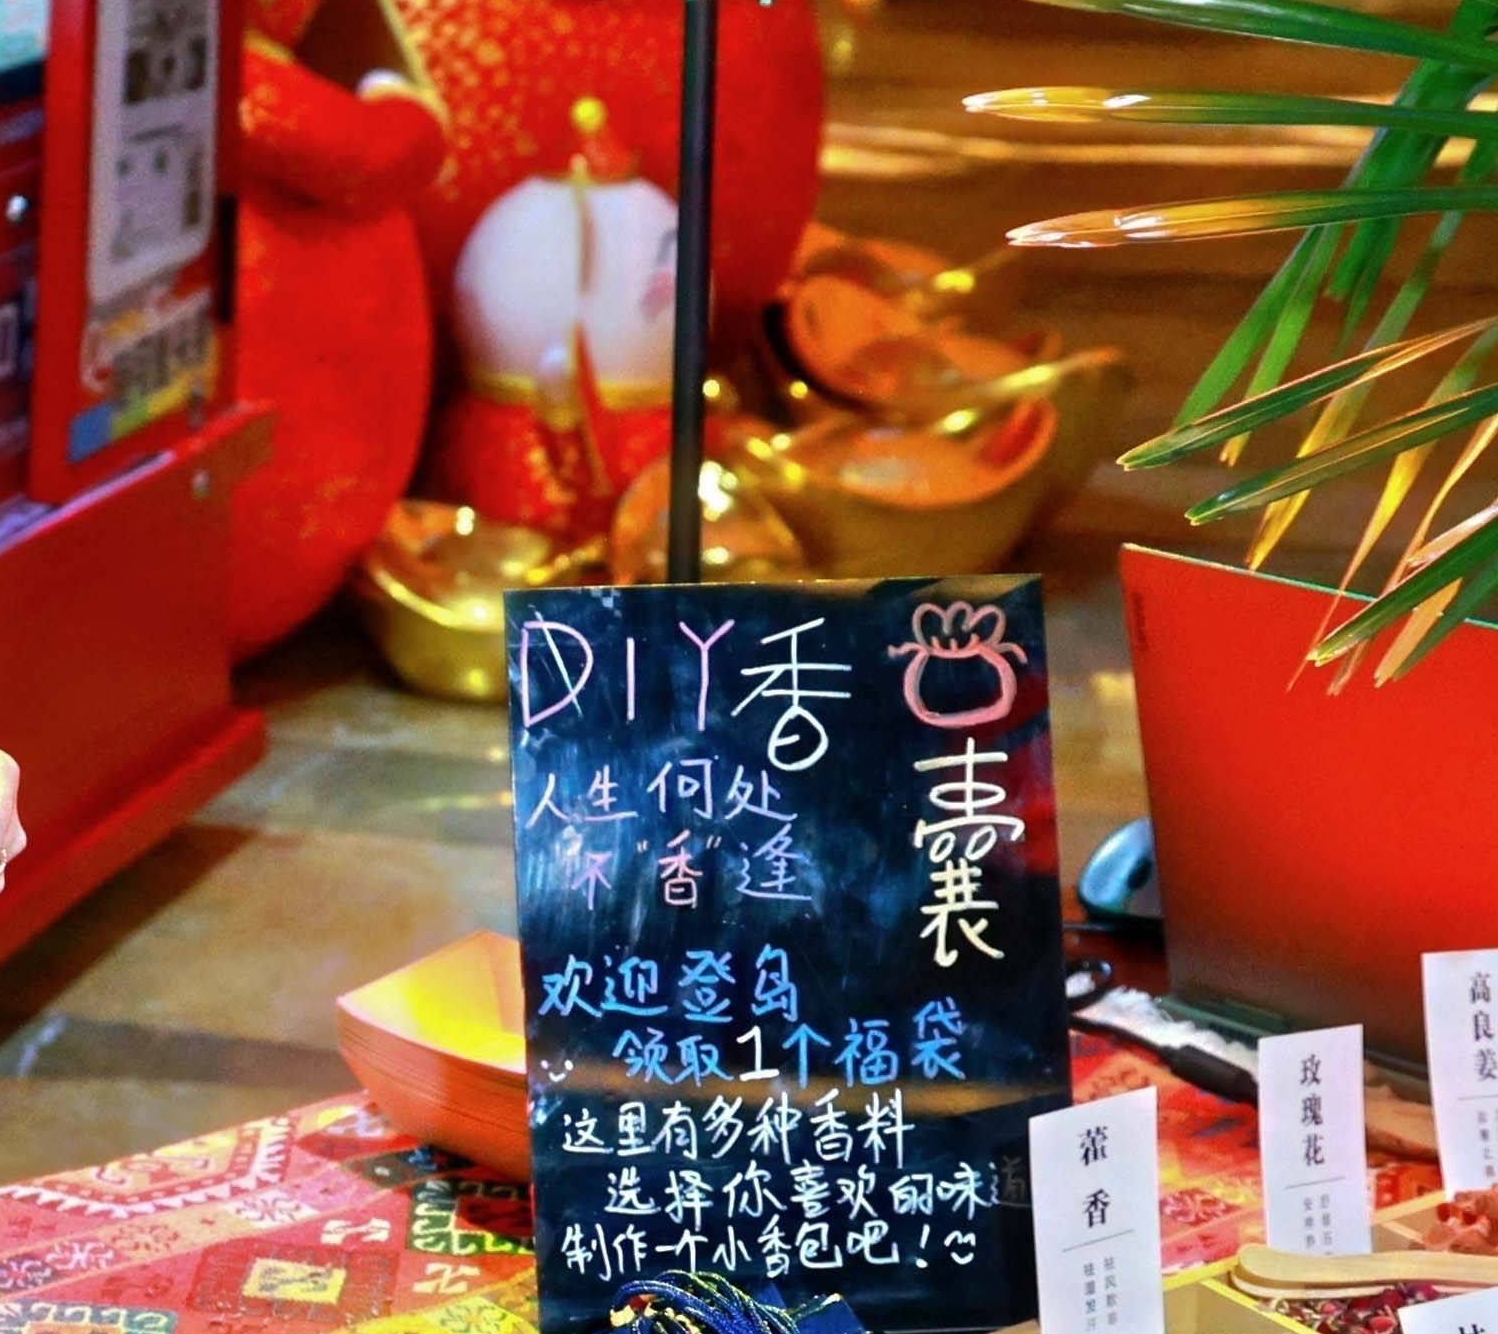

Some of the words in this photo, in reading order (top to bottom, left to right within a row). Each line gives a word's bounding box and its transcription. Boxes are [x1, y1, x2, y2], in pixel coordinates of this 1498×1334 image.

[526, 758, 797, 828] 人生何处
[539, 944, 797, 1023] 欢迎登岛
[1469, 972, 1498, 1081] 高良姜
[613, 997, 966, 1086] 领取1个福袋
[562, 1088, 914, 1165] 这里有多种香料
[1300, 1054, 1326, 1166] 玫瑰花
[1079, 1126, 1110, 1228] 藿香
